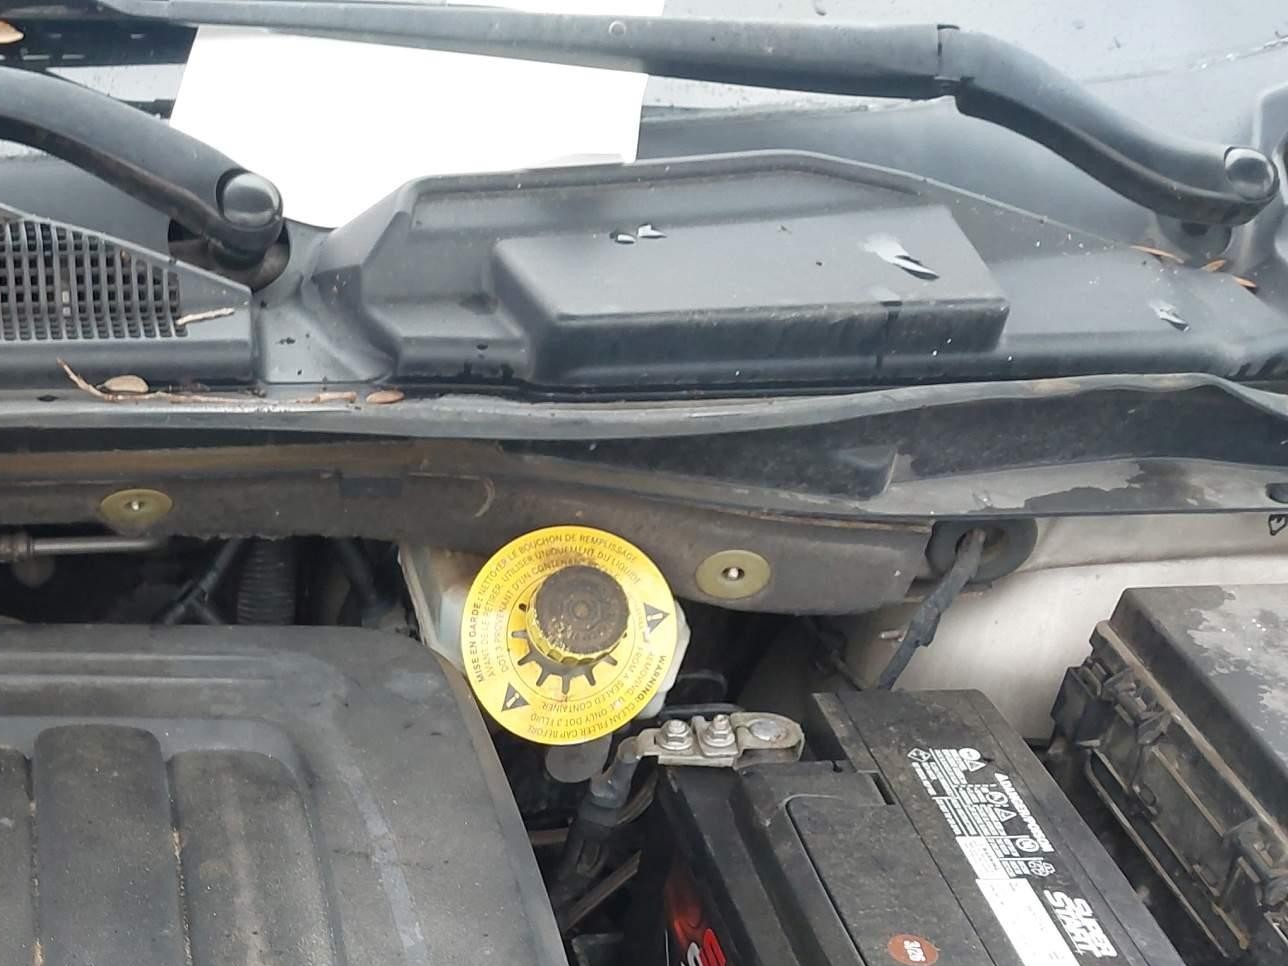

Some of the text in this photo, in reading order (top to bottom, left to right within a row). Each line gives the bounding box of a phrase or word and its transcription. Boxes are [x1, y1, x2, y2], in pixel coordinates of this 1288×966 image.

[468, 641, 478, 654] EN
[518, 534, 560, 553] BOUCHON
[565, 532, 575, 541] DE
[635, 655, 665, 704] WARNING:
[1044, 889, 1095, 954] START
[1072, 898, 1117, 959] SUPER
